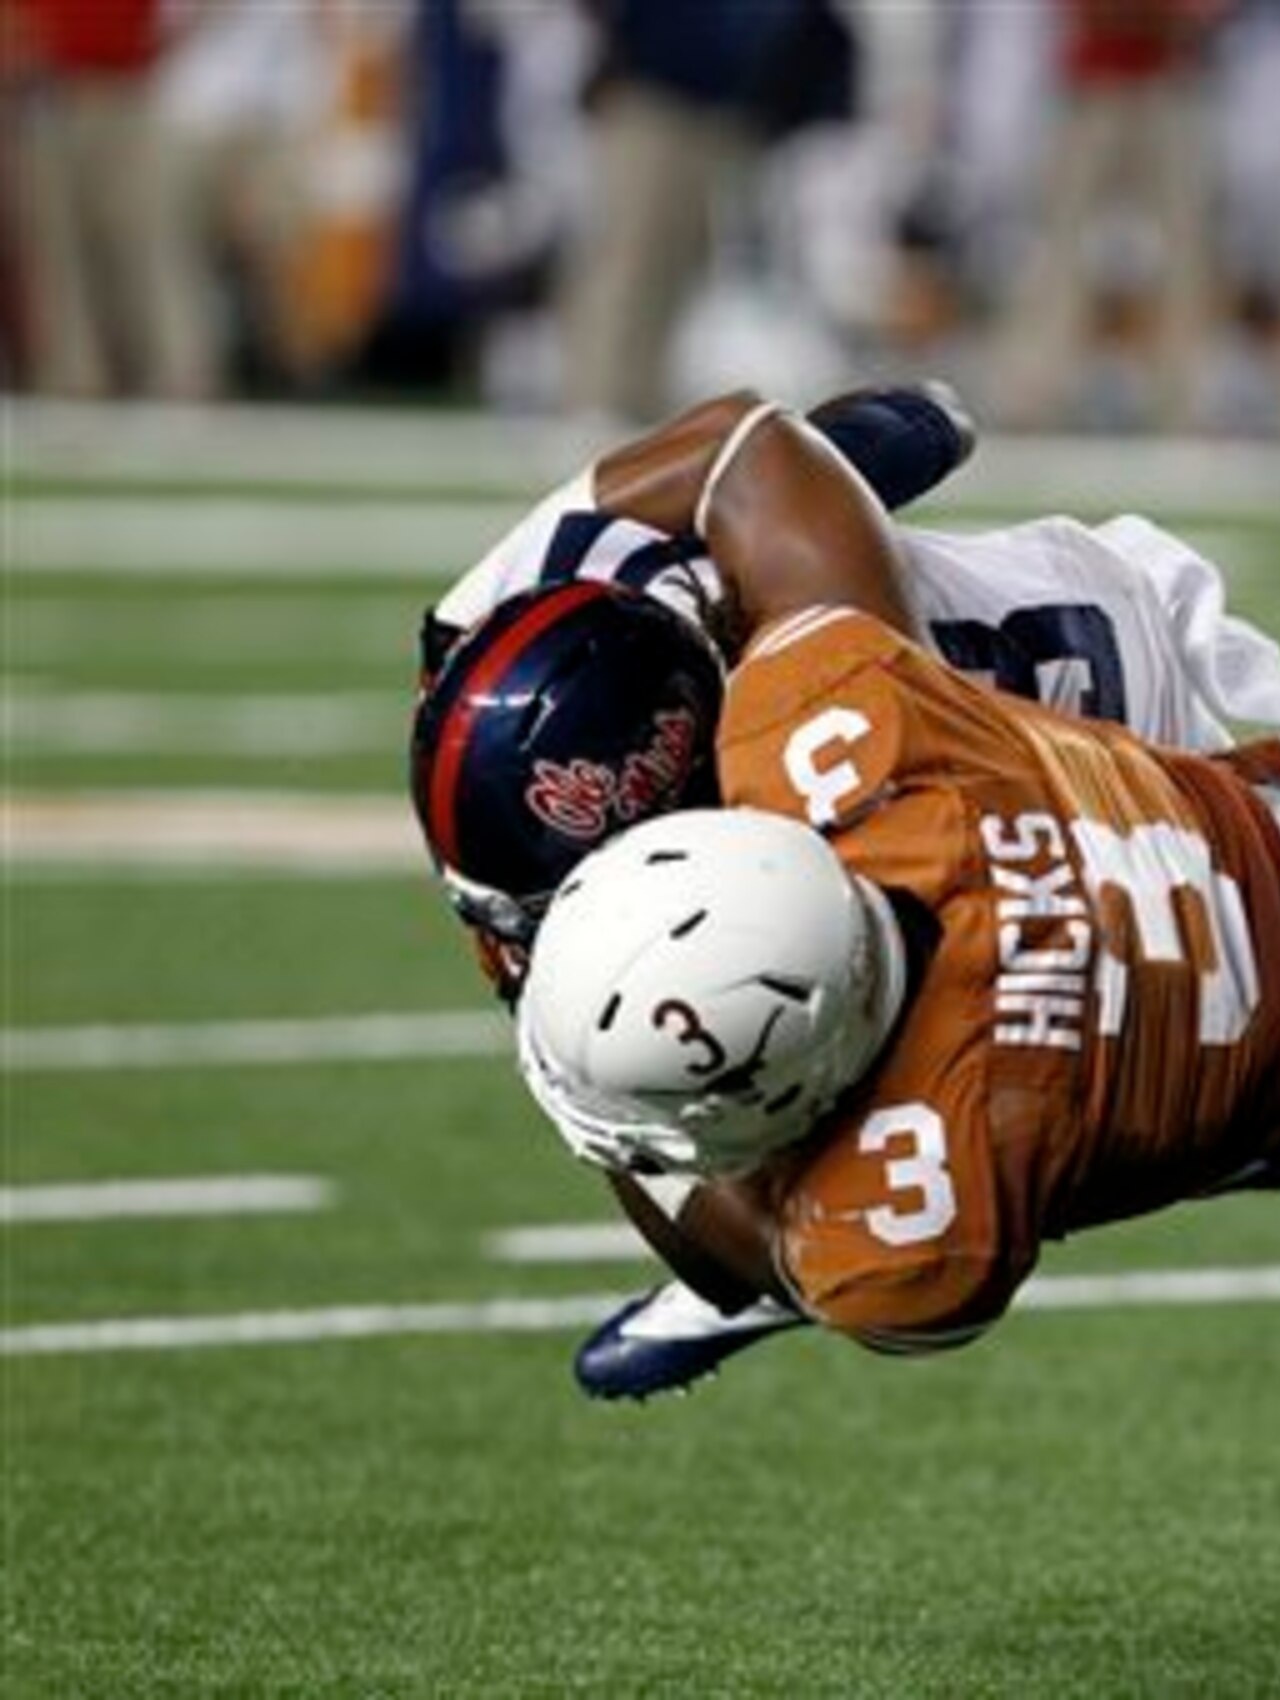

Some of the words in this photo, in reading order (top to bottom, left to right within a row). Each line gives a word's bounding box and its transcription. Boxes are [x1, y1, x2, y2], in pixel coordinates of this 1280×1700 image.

[979, 811, 1092, 1051] HICKS
[1069, 820, 1261, 1045] 3
[652, 998, 726, 1077] 3
[859, 1101, 957, 1247] 3
